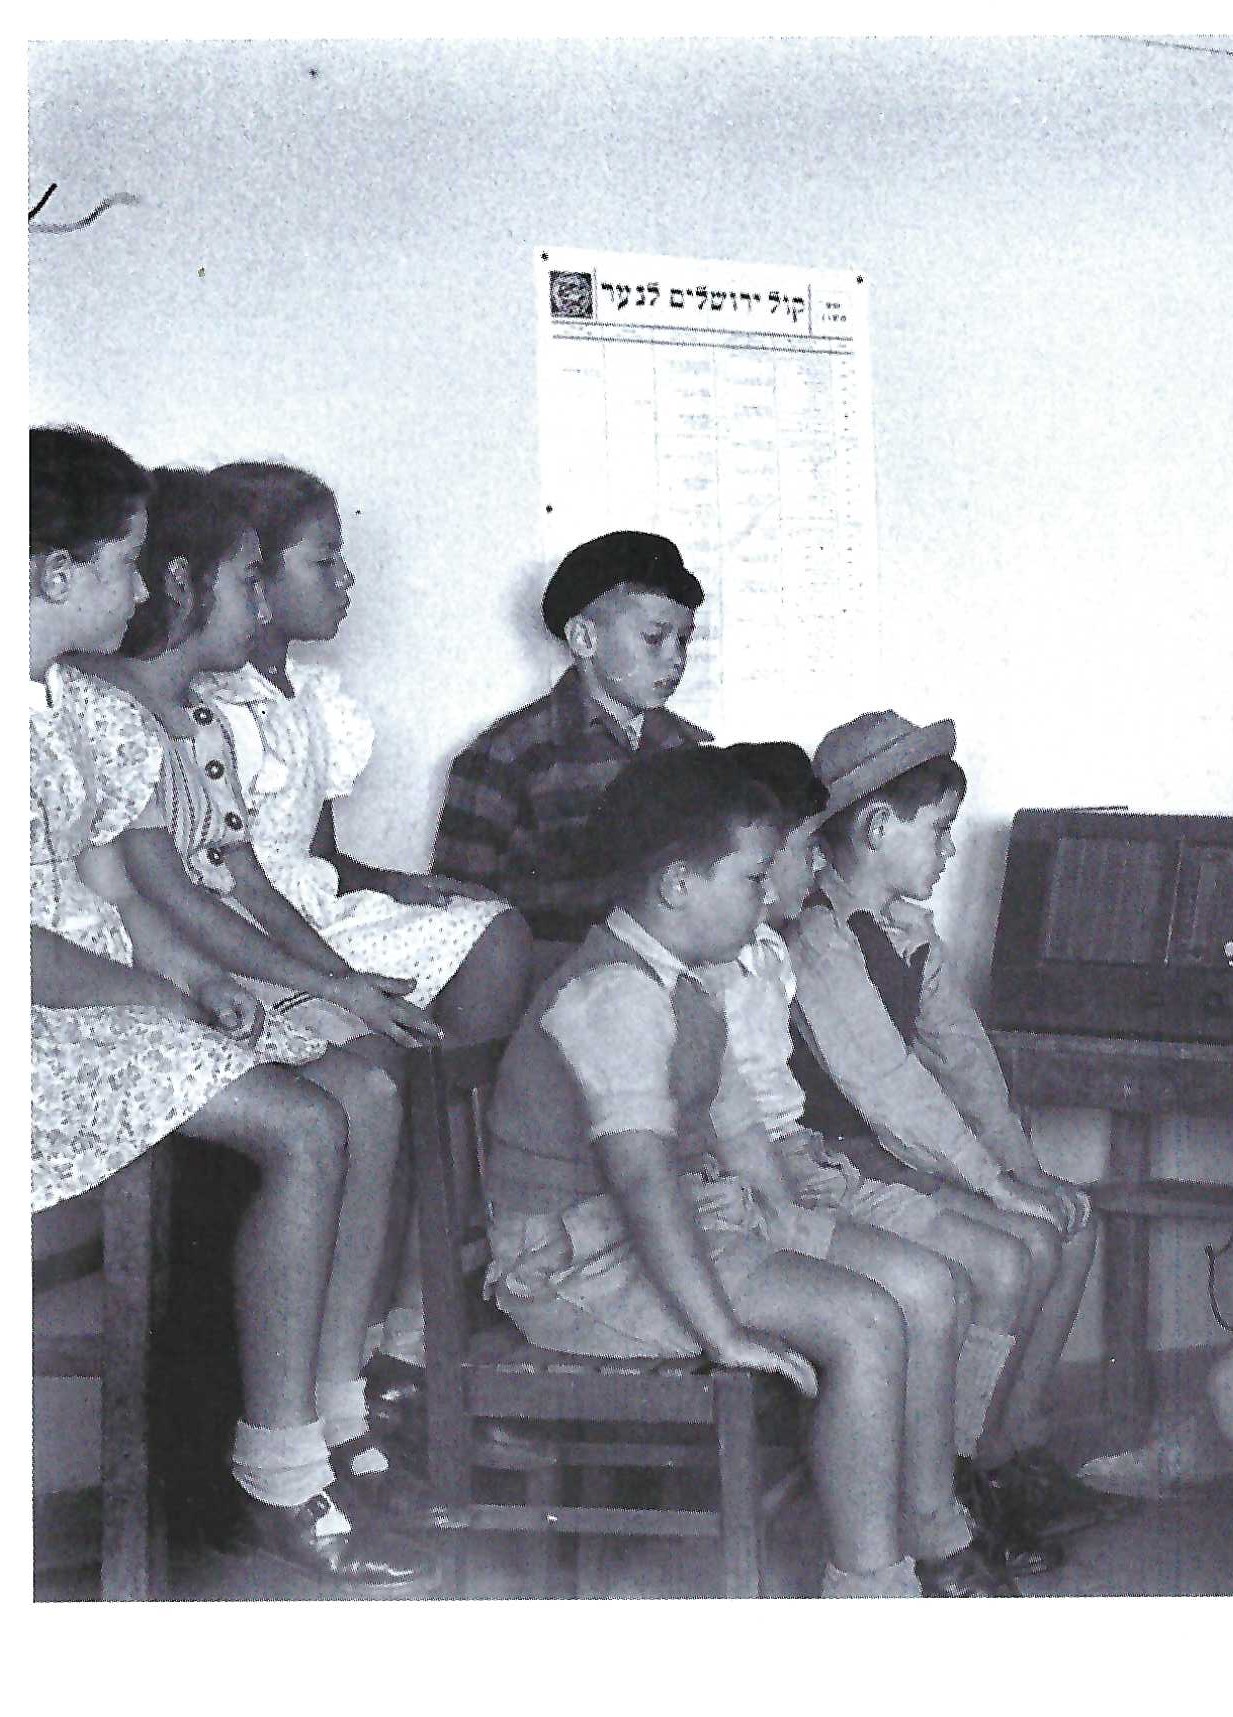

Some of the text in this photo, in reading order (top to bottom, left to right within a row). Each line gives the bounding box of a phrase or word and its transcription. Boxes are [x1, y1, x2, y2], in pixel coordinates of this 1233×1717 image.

[601, 281, 804, 322] קול ירושלים לנער
